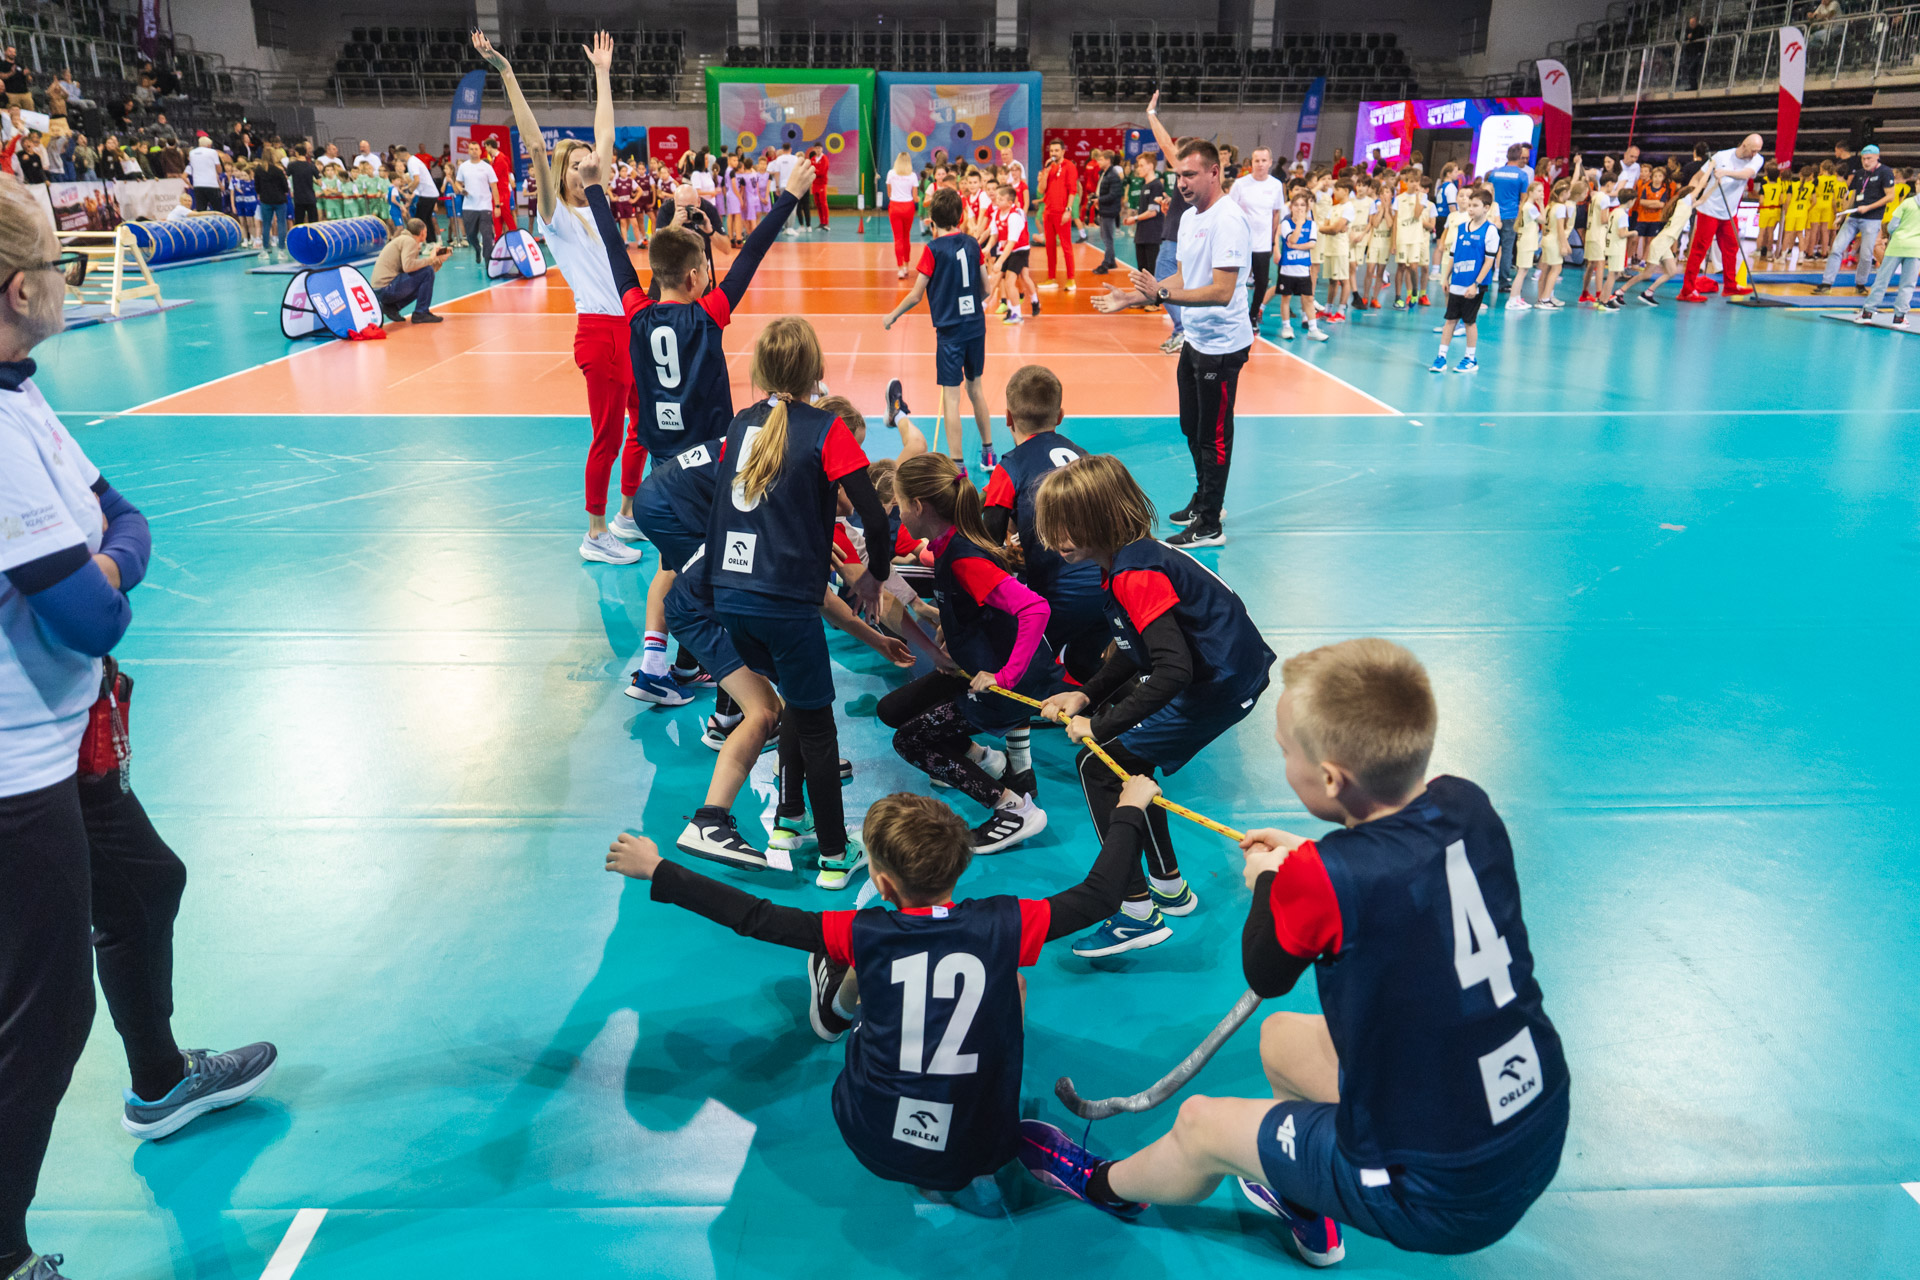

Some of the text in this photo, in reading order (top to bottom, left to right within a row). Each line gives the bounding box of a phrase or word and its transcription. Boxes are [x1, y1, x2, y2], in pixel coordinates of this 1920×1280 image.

[1770, 188, 1777, 201] 7
[956, 247, 970, 288] 1
[650, 325, 681, 389] 9
[728, 557, 749, 567] ORLEN
[1445, 838, 1517, 1009] 4
[890, 951, 986, 1075] 12
[1499, 1077, 1536, 1107] ORLEN
[902, 1127, 939, 1143] ORLEN
[1276, 1114, 1296, 1161] 4F
